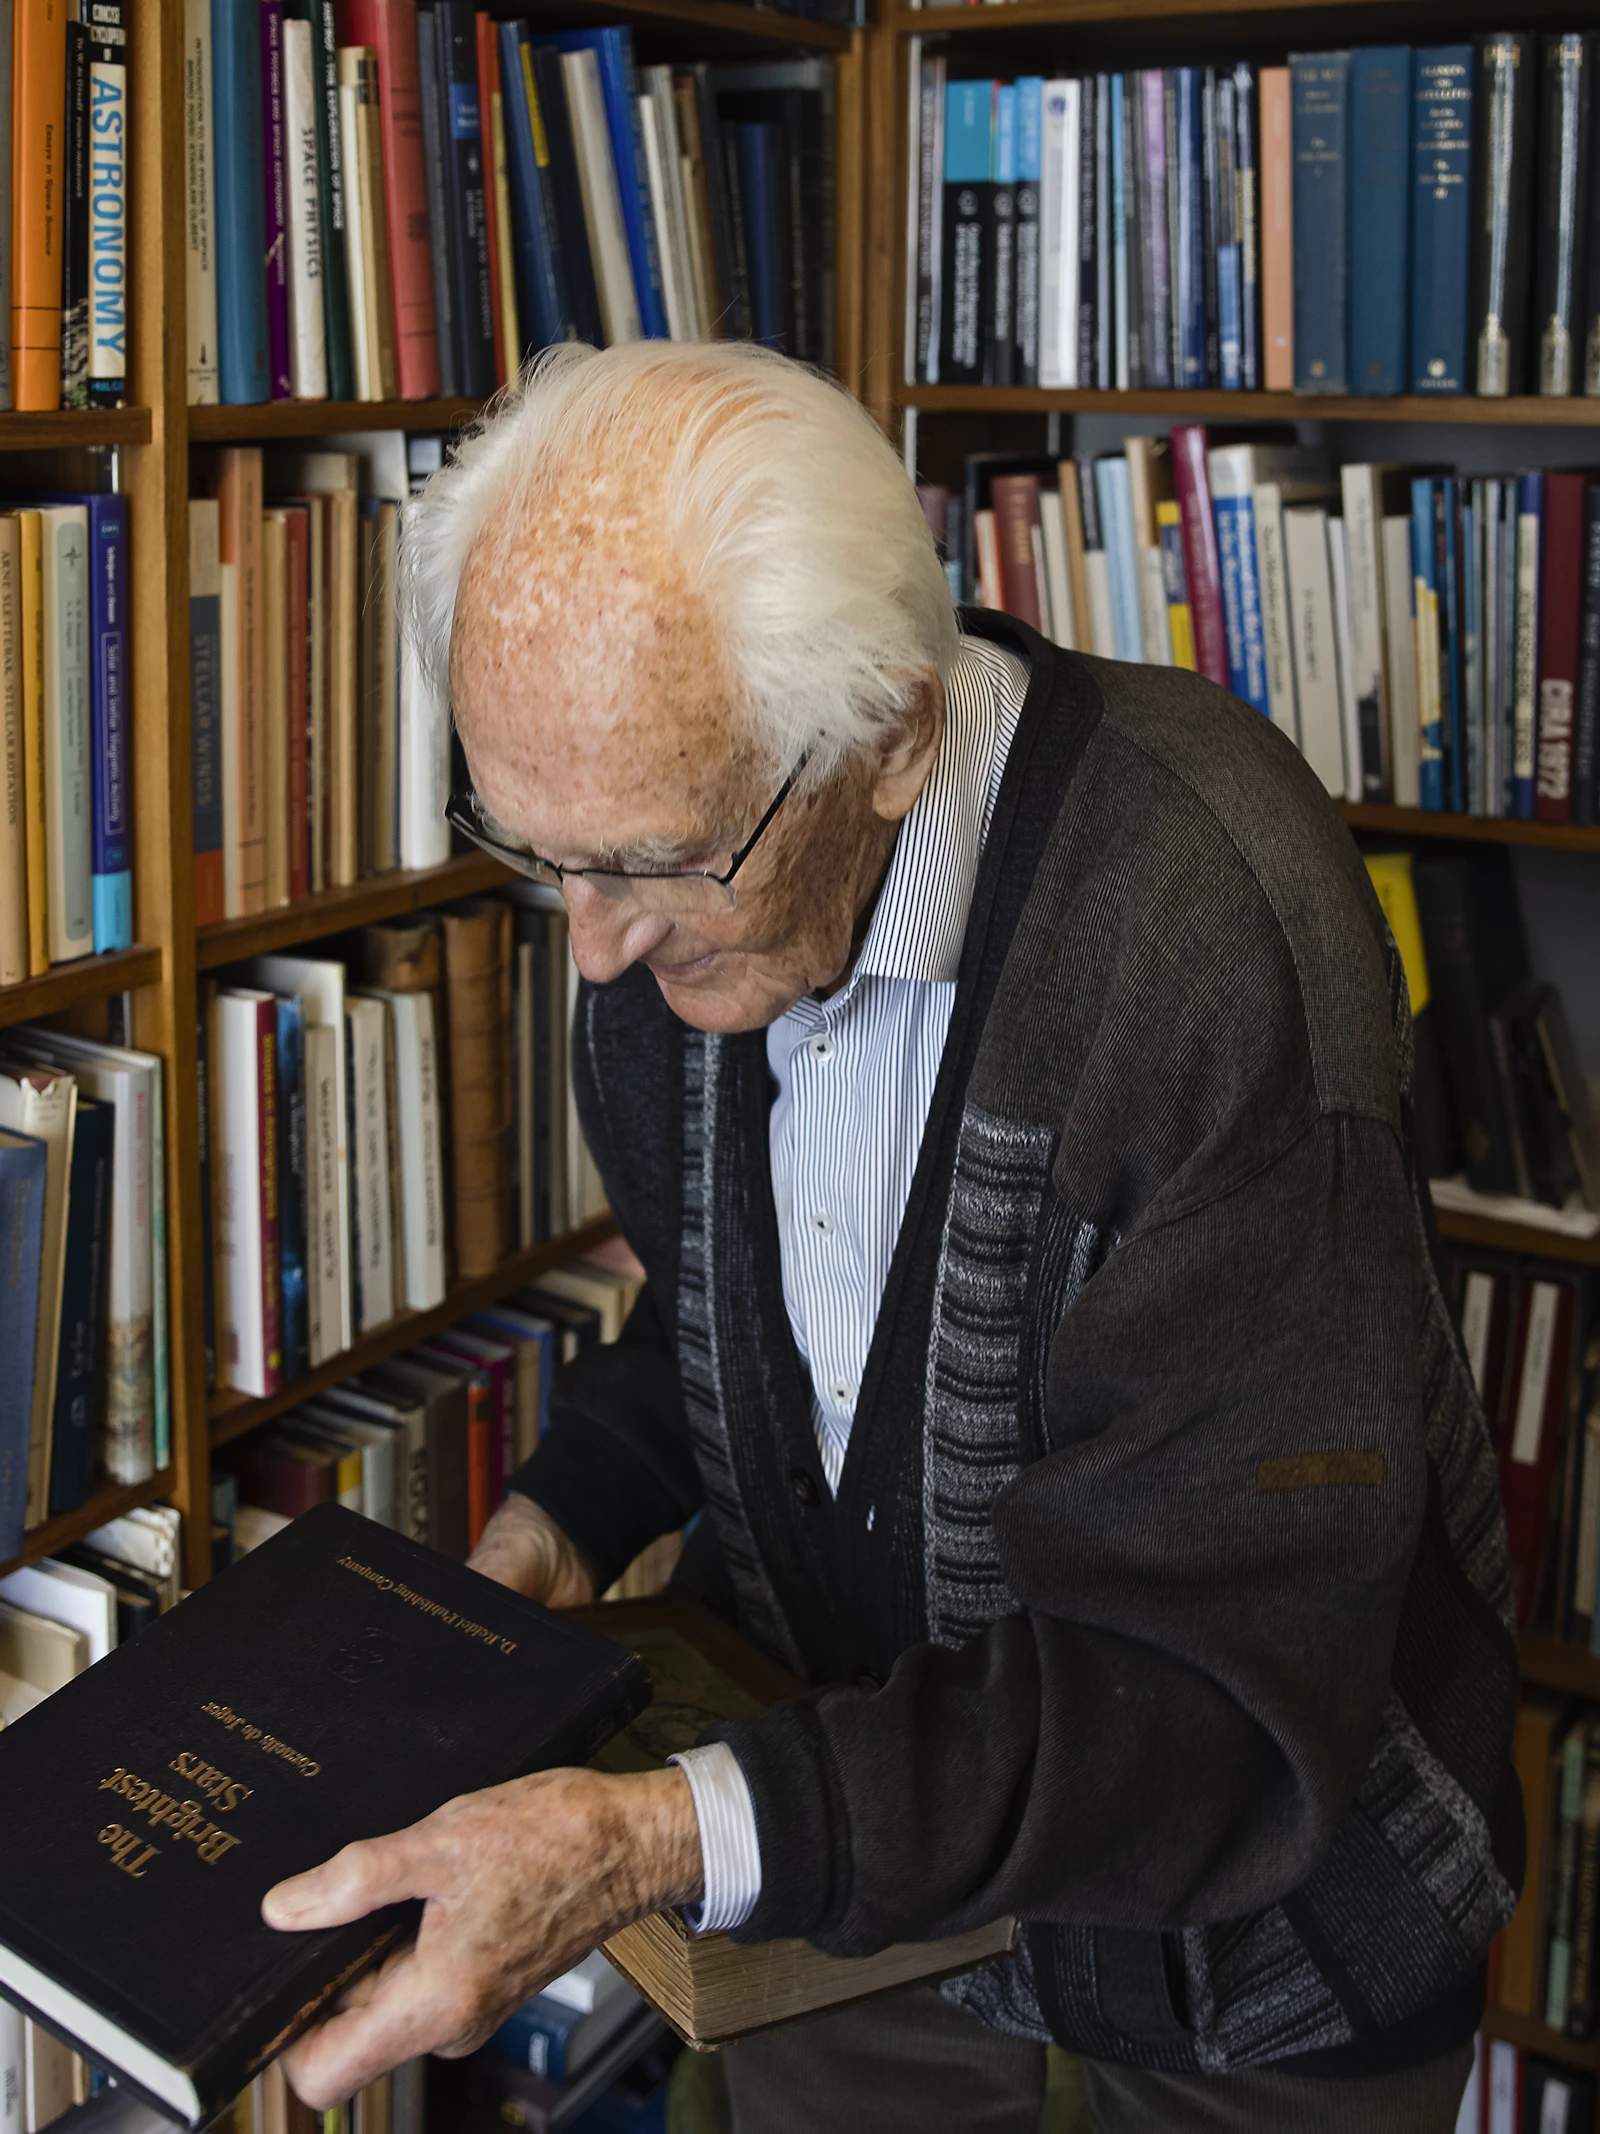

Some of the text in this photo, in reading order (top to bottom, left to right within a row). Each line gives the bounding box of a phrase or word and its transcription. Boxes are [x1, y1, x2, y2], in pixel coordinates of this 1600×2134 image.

[269, 12, 280, 48] SPACE
[270, 50, 281, 96] PHYSICS
[325, 63, 337, 86] THE
[272, 97, 281, 122] AND
[272, 123, 282, 158] SPACE
[327, 90, 342, 170] EXPLORATION
[45, 124, 55, 257] Essays in Space Science
[273, 159, 284, 227] ASTRONOMY
[301, 126, 322, 280] SPACE PHYSICS
[332, 173, 342, 189] OF
[333, 191, 345, 230] SPACE
[92, 77, 125, 354] ASTRONOMY
[106, 545, 117, 581] Schrijver
[106, 644, 122, 822] Solar and Stellar Magnetic Activity
[194, 632, 213, 807] STELLAR WINDS
[1537, 678, 1574, 800] CIRA 1972
[338, 1556, 518, 1655] D. Reidel Publishing Company
[200, 1701, 321, 1778] Cornelis de Jager
[167, 1751, 255, 1812] Stars
[97, 1767, 242, 1866] Brightest
[97, 1823, 163, 1879] The
